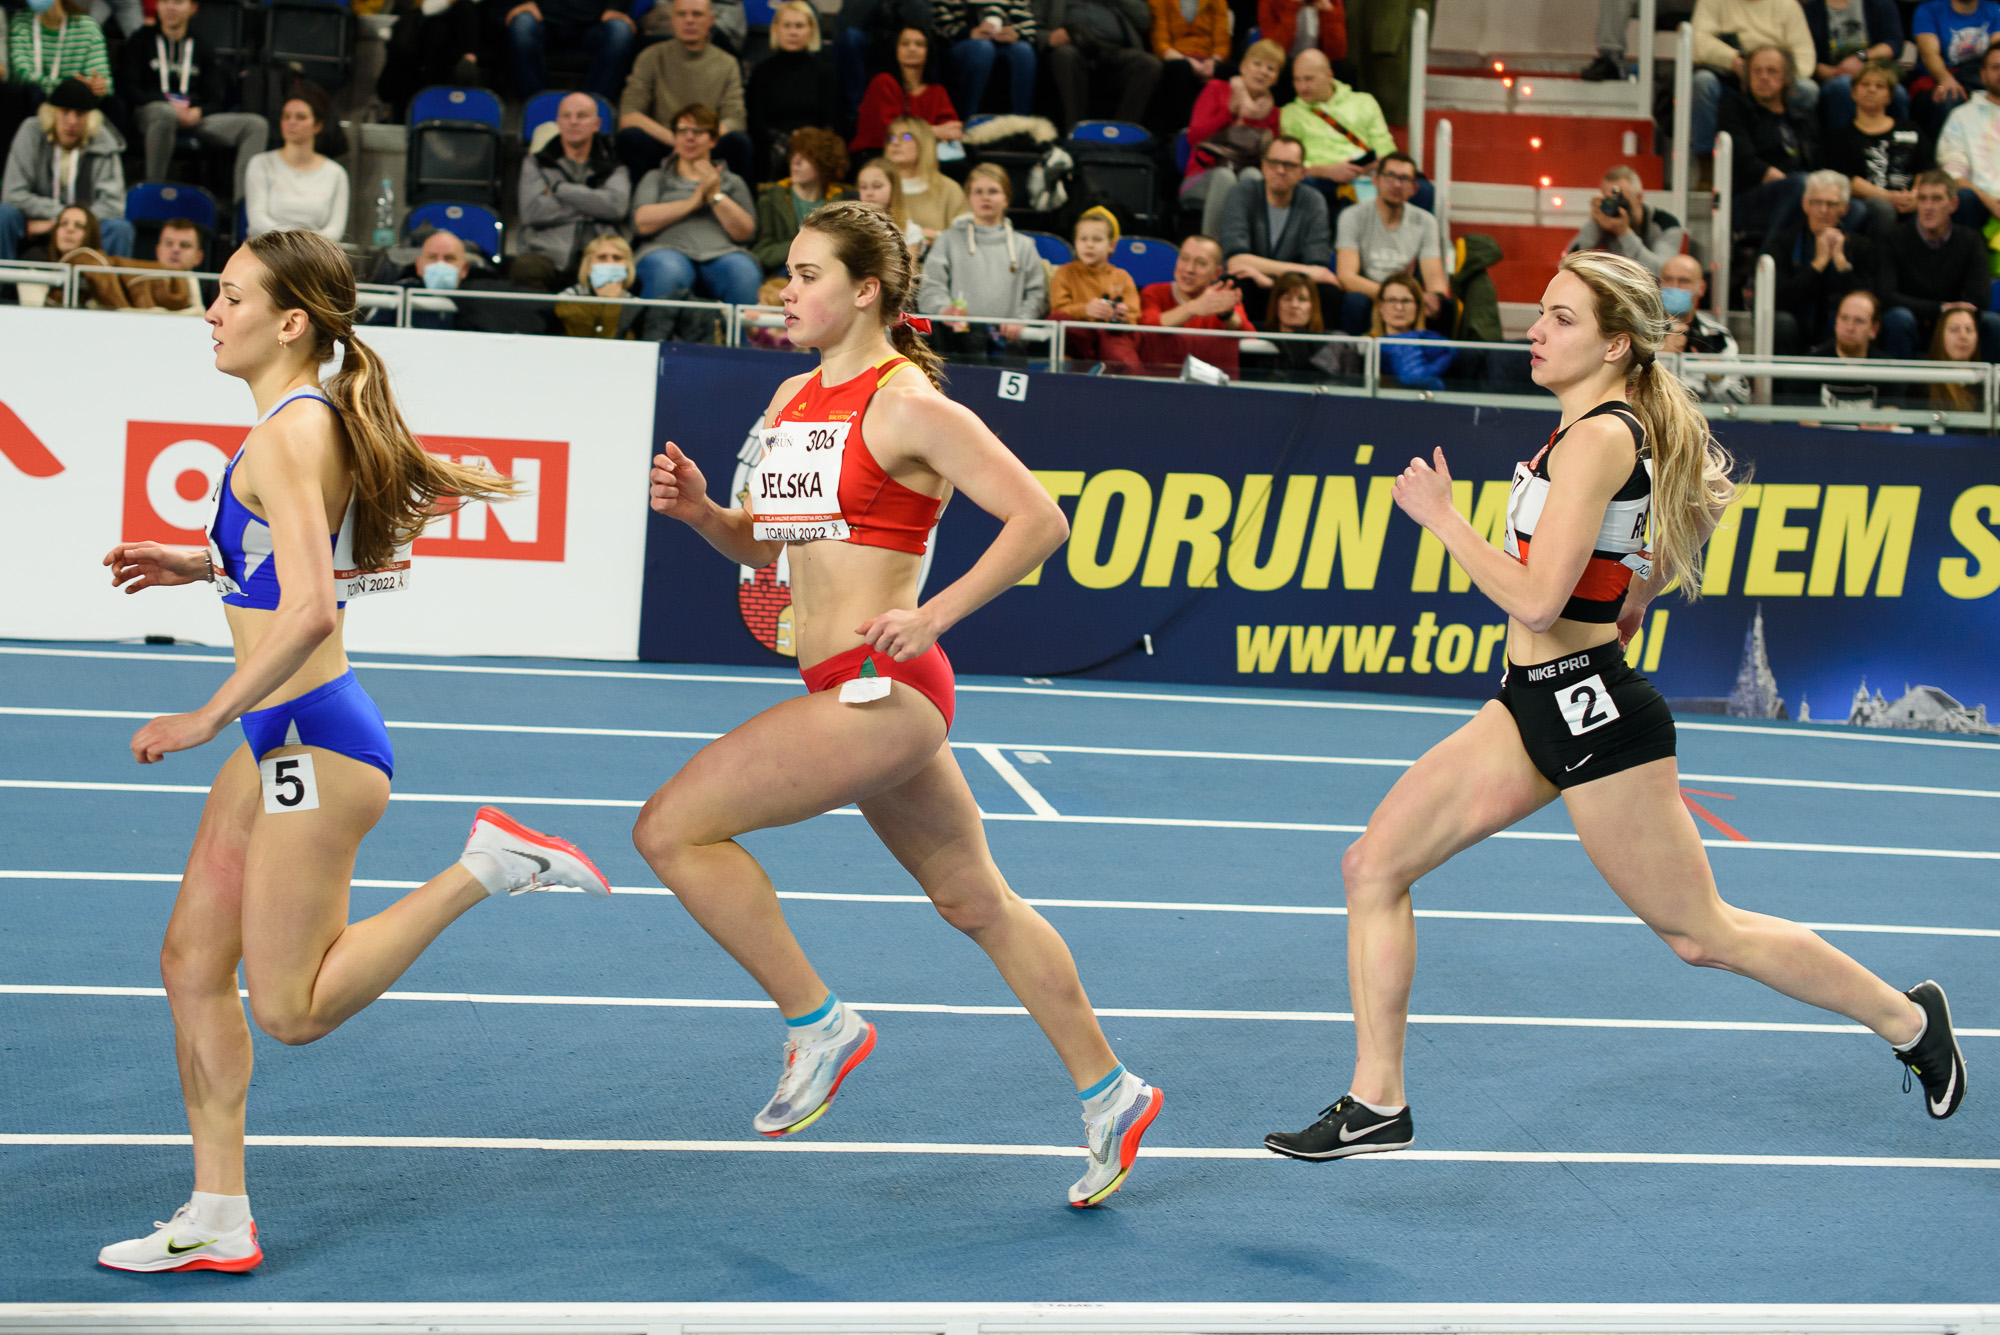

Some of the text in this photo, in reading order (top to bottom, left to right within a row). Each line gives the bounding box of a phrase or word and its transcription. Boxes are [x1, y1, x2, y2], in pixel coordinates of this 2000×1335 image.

[1006, 375, 1021, 396] 5
[806, 428, 838, 452] 306
[761, 471, 823, 498] JELSKA
[765, 524, 828, 540] TORUŃ 2022
[369, 576, 395, 592] 2022
[1527, 654, 1591, 682] NIKE PRO
[1570, 685, 1608, 728] 2
[275, 759, 305, 807] 5
